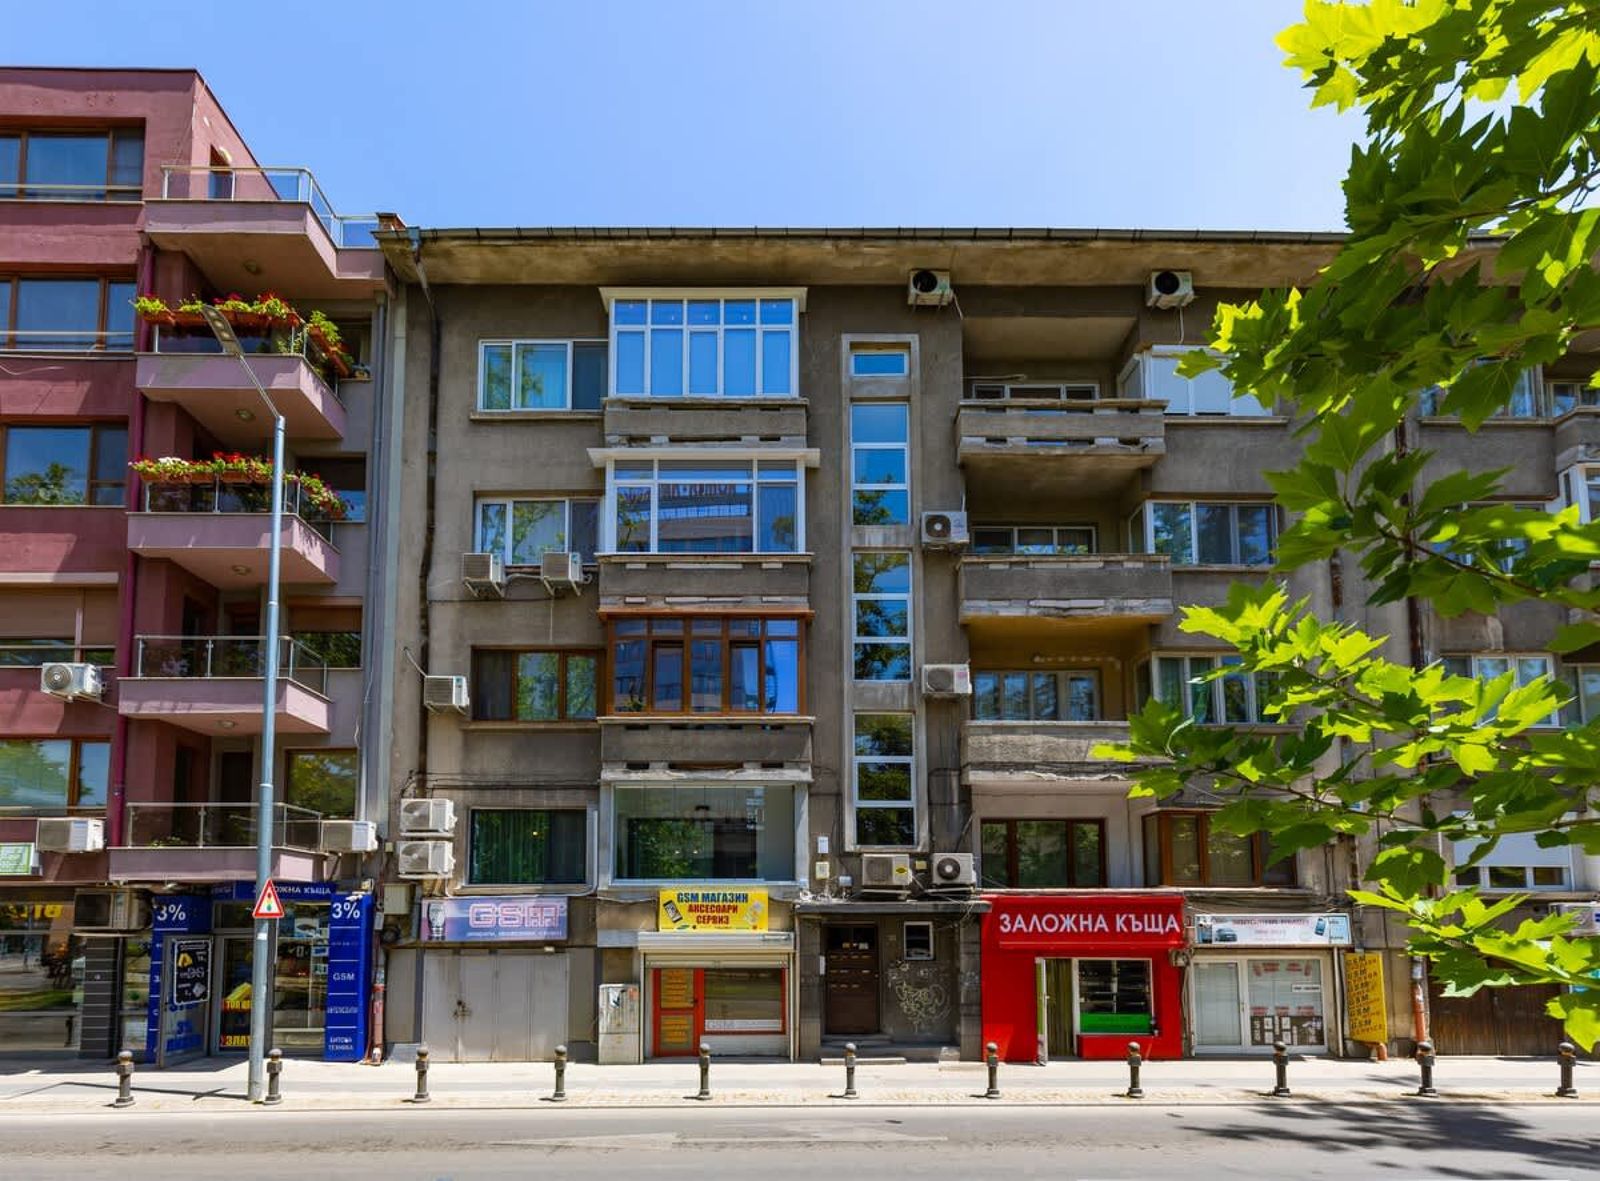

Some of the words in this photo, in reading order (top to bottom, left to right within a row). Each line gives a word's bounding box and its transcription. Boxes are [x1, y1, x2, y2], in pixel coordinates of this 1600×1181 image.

[677, 892, 699, 903] GSM
[701, 892, 749, 903] МАГАЗИН
[332, 902, 360, 919] 3%
[688, 904, 738, 914] АКСЕСОАРИ
[696, 915, 729, 925] СЕРВИЗ
[999, 913, 1109, 934] ЗАЛОЖНА
[1115, 913, 1181, 935] КЪЩА
[333, 972, 355, 981] GSM
